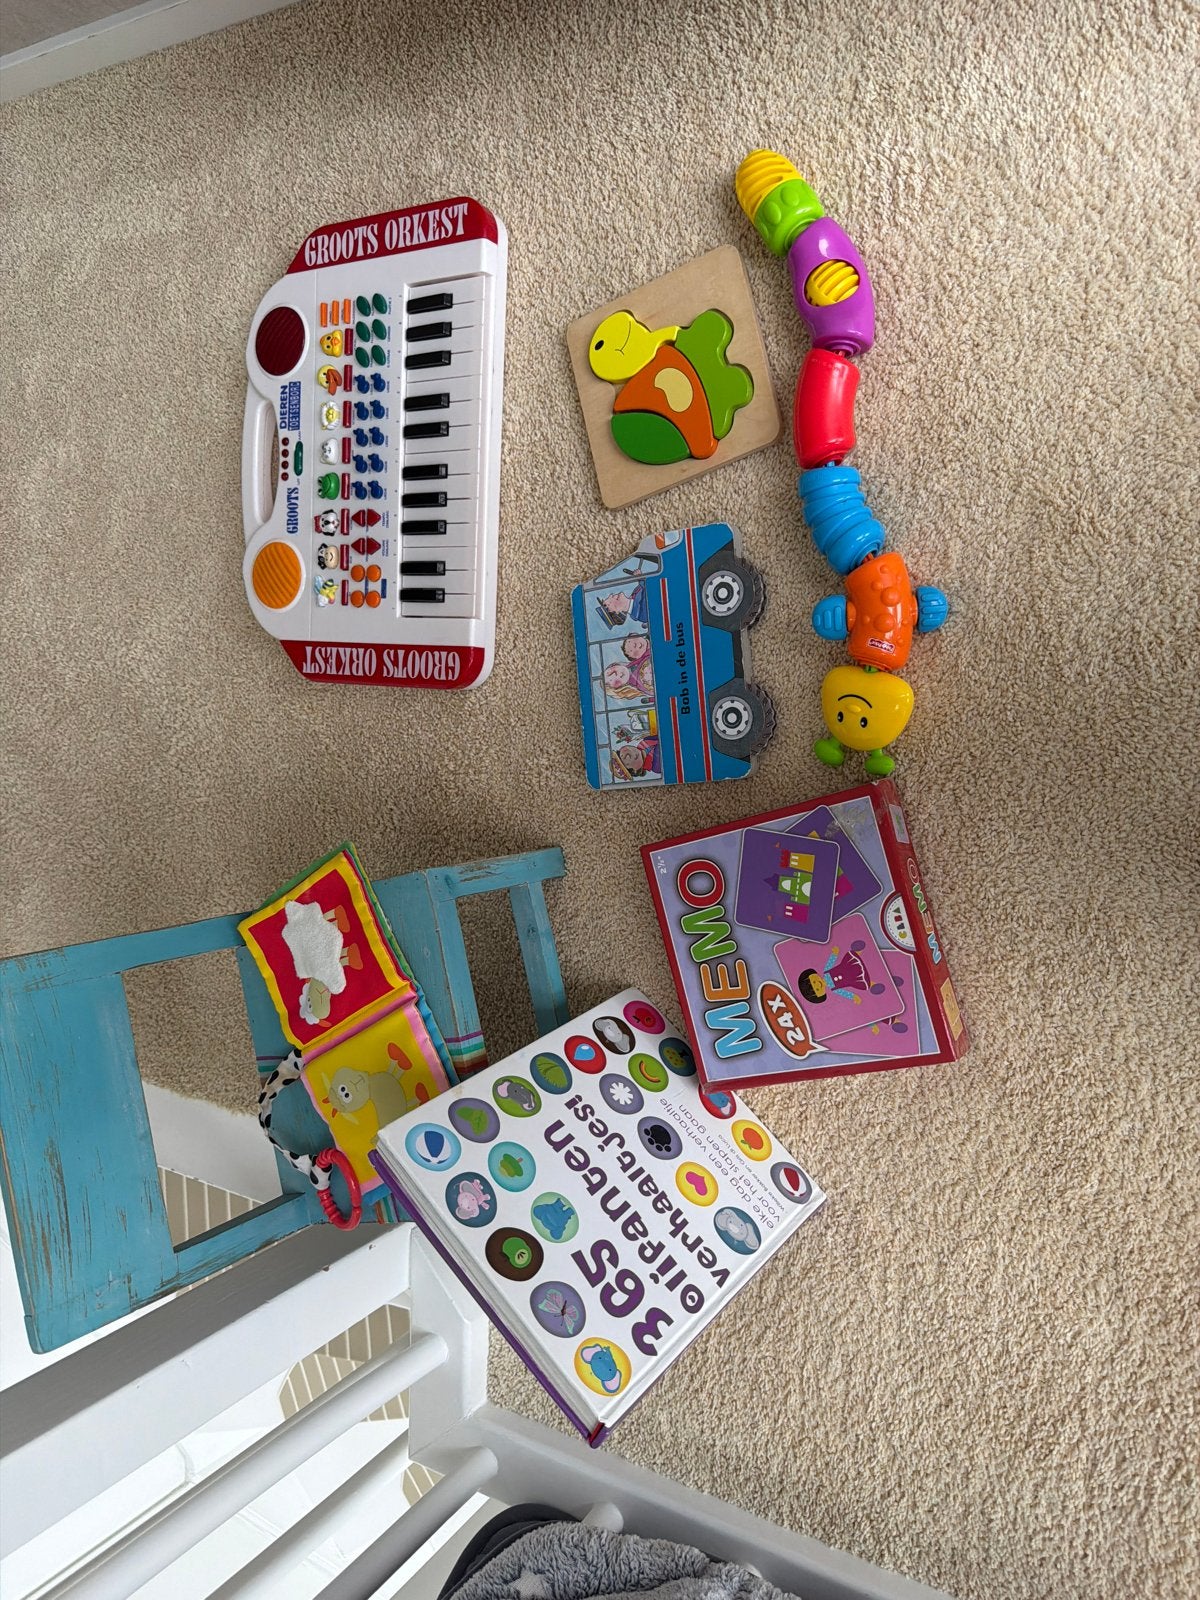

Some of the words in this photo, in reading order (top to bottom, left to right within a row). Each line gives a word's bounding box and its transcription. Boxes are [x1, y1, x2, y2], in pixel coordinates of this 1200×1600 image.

[304, 222, 378, 267] GROOTS
[384, 202, 469, 251] ORKEST
[280, 385, 289, 429] DIEREN
[286, 486, 299, 534] GROOTS
[675, 622, 685, 647] bus
[302, 646, 377, 677] ORKEST
[383, 649, 461, 681] GROOTS
[676, 651, 686, 667] de
[678, 671, 688, 684] in
[680, 688, 691, 714] Bob
[906, 857, 942, 965] MEMO
[677, 859, 762, 1059] MEMO
[660, 1098, 707, 1152] verhaaltje
[679, 1104, 707, 1134] gaan
[706, 1135, 740, 1173] slapen
[708, 1153, 729, 1176] een
[564, 1094, 731, 1289] verhaaltjes!
[729, 1176, 752, 1203] dag
[739, 1174, 758, 1195] het
[543, 1119, 705, 1314] olifanten
[753, 1204, 774, 1229] elke
[757, 1196, 780, 1222] voor
[570, 1239, 675, 1356] 365
